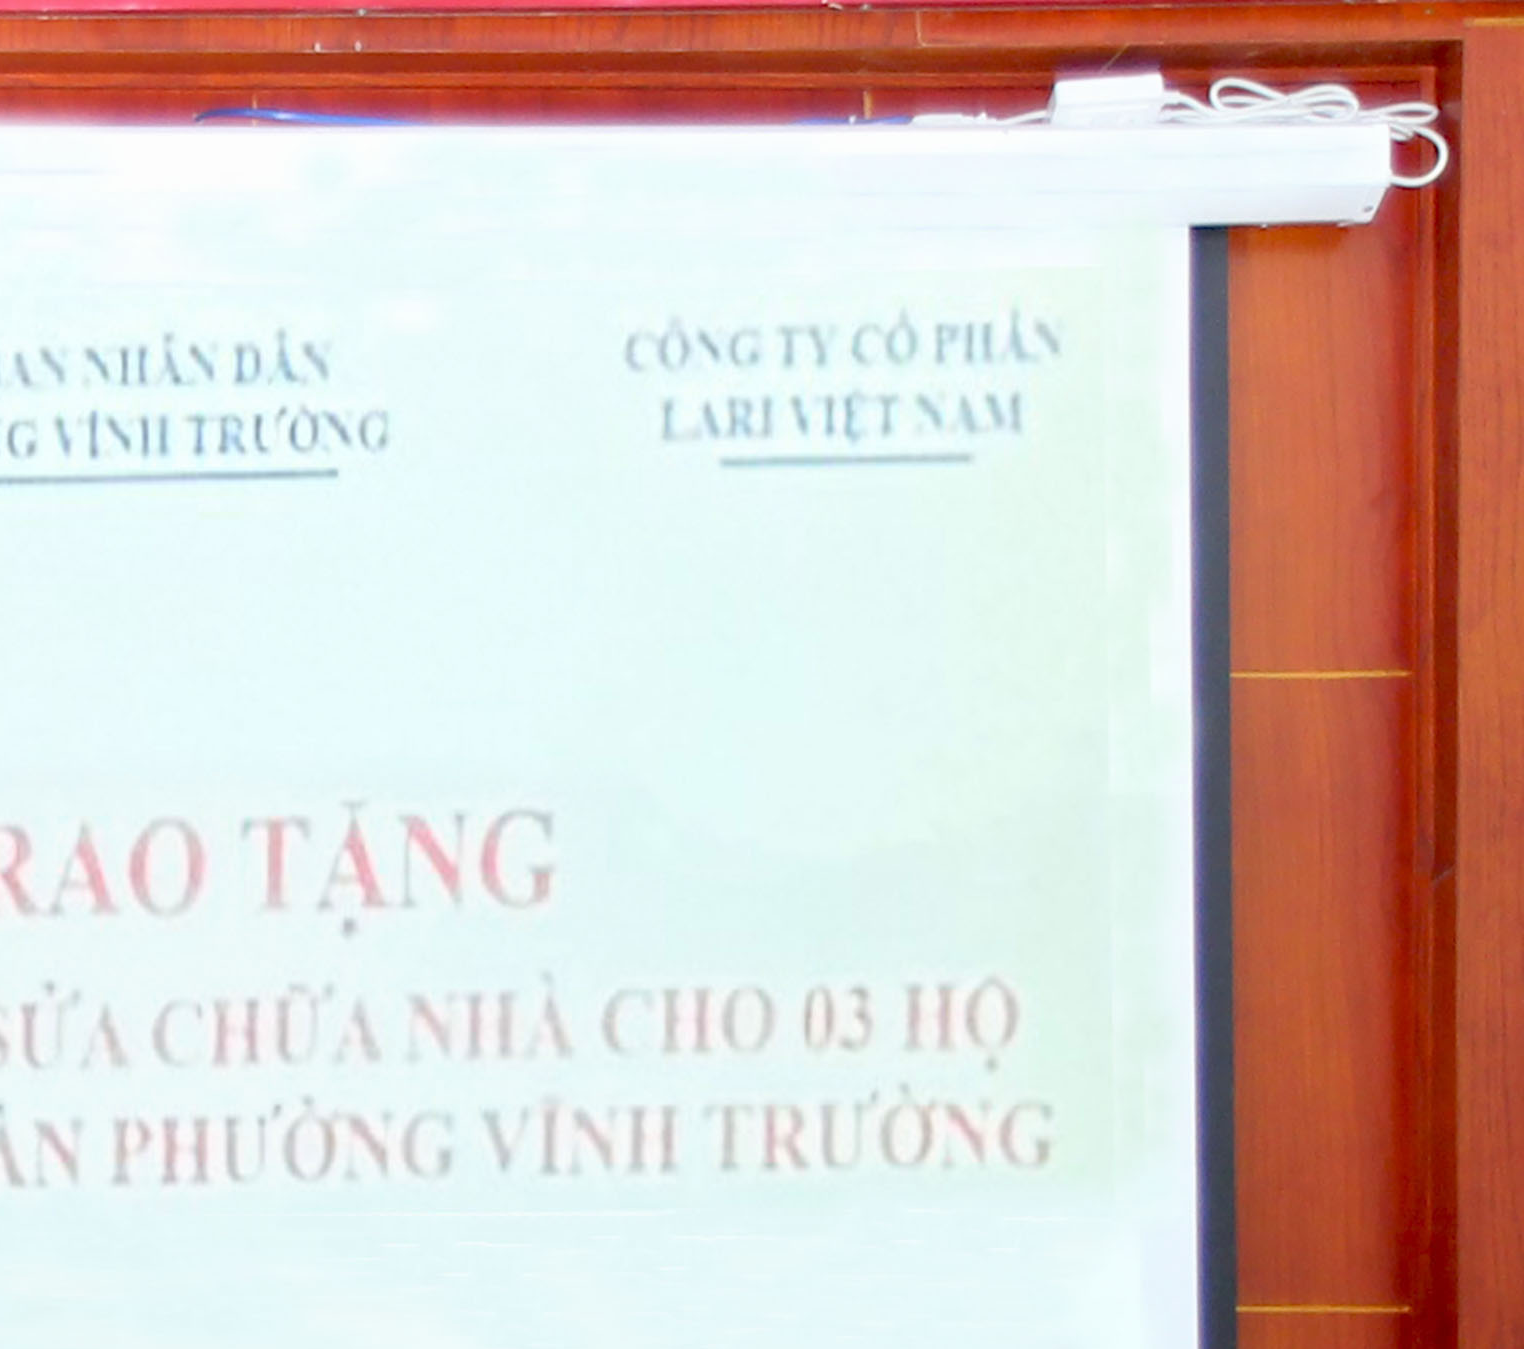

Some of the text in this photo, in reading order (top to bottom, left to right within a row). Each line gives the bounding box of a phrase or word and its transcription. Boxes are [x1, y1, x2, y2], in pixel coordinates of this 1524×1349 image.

[84, 332, 217, 387] NHÂN
[233, 329, 333, 386] DÂN
[625, 317, 761, 371] CÔNG
[777, 325, 834, 368] TY
[54, 409, 169, 460] VĨNH
[185, 405, 390, 455] TRƯỜNG
[662, 390, 1023, 443] LARI VIỆT NAM
[241, 802, 555, 938] TẶNG
[151, 983, 383, 1068] CHỮA
[405, 971, 575, 1061] NHÀ
[602, 985, 776, 1057] CHO
[802, 985, 874, 1053] 03
[901, 975, 1021, 1073] HỘ
[112, 1094, 456, 1186] PHƯỜNG
[481, 1094, 678, 1177] VĨNH
[703, 1081, 1055, 1175] TRƯỜNG
